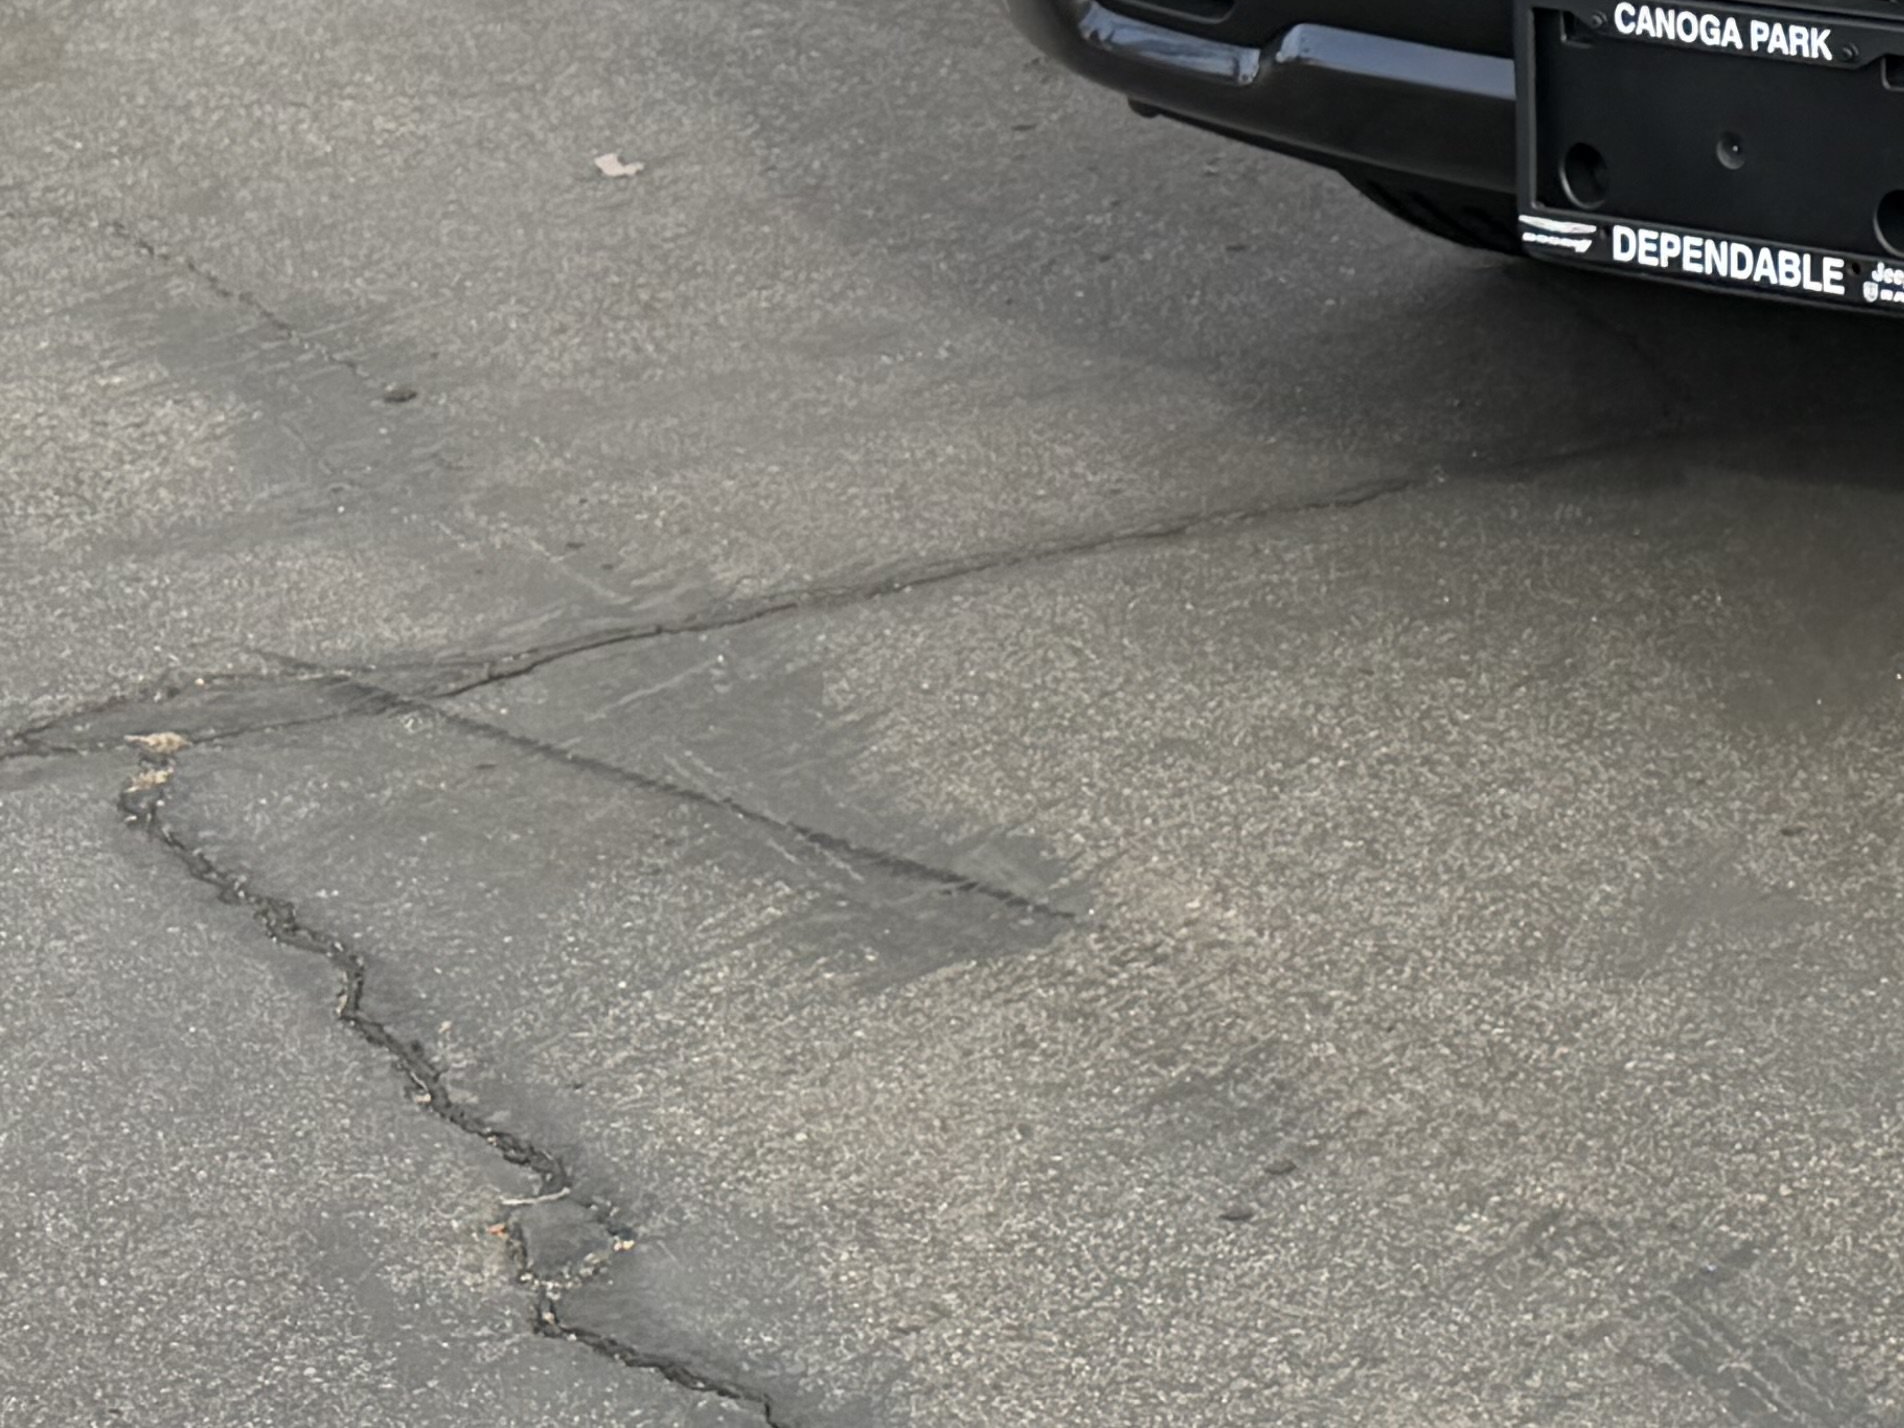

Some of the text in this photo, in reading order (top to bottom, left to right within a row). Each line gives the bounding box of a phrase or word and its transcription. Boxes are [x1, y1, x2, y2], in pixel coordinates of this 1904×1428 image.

[1614, 1, 1833, 61] CANOGA PARK
[1612, 224, 1845, 294] DEPENDABLE
